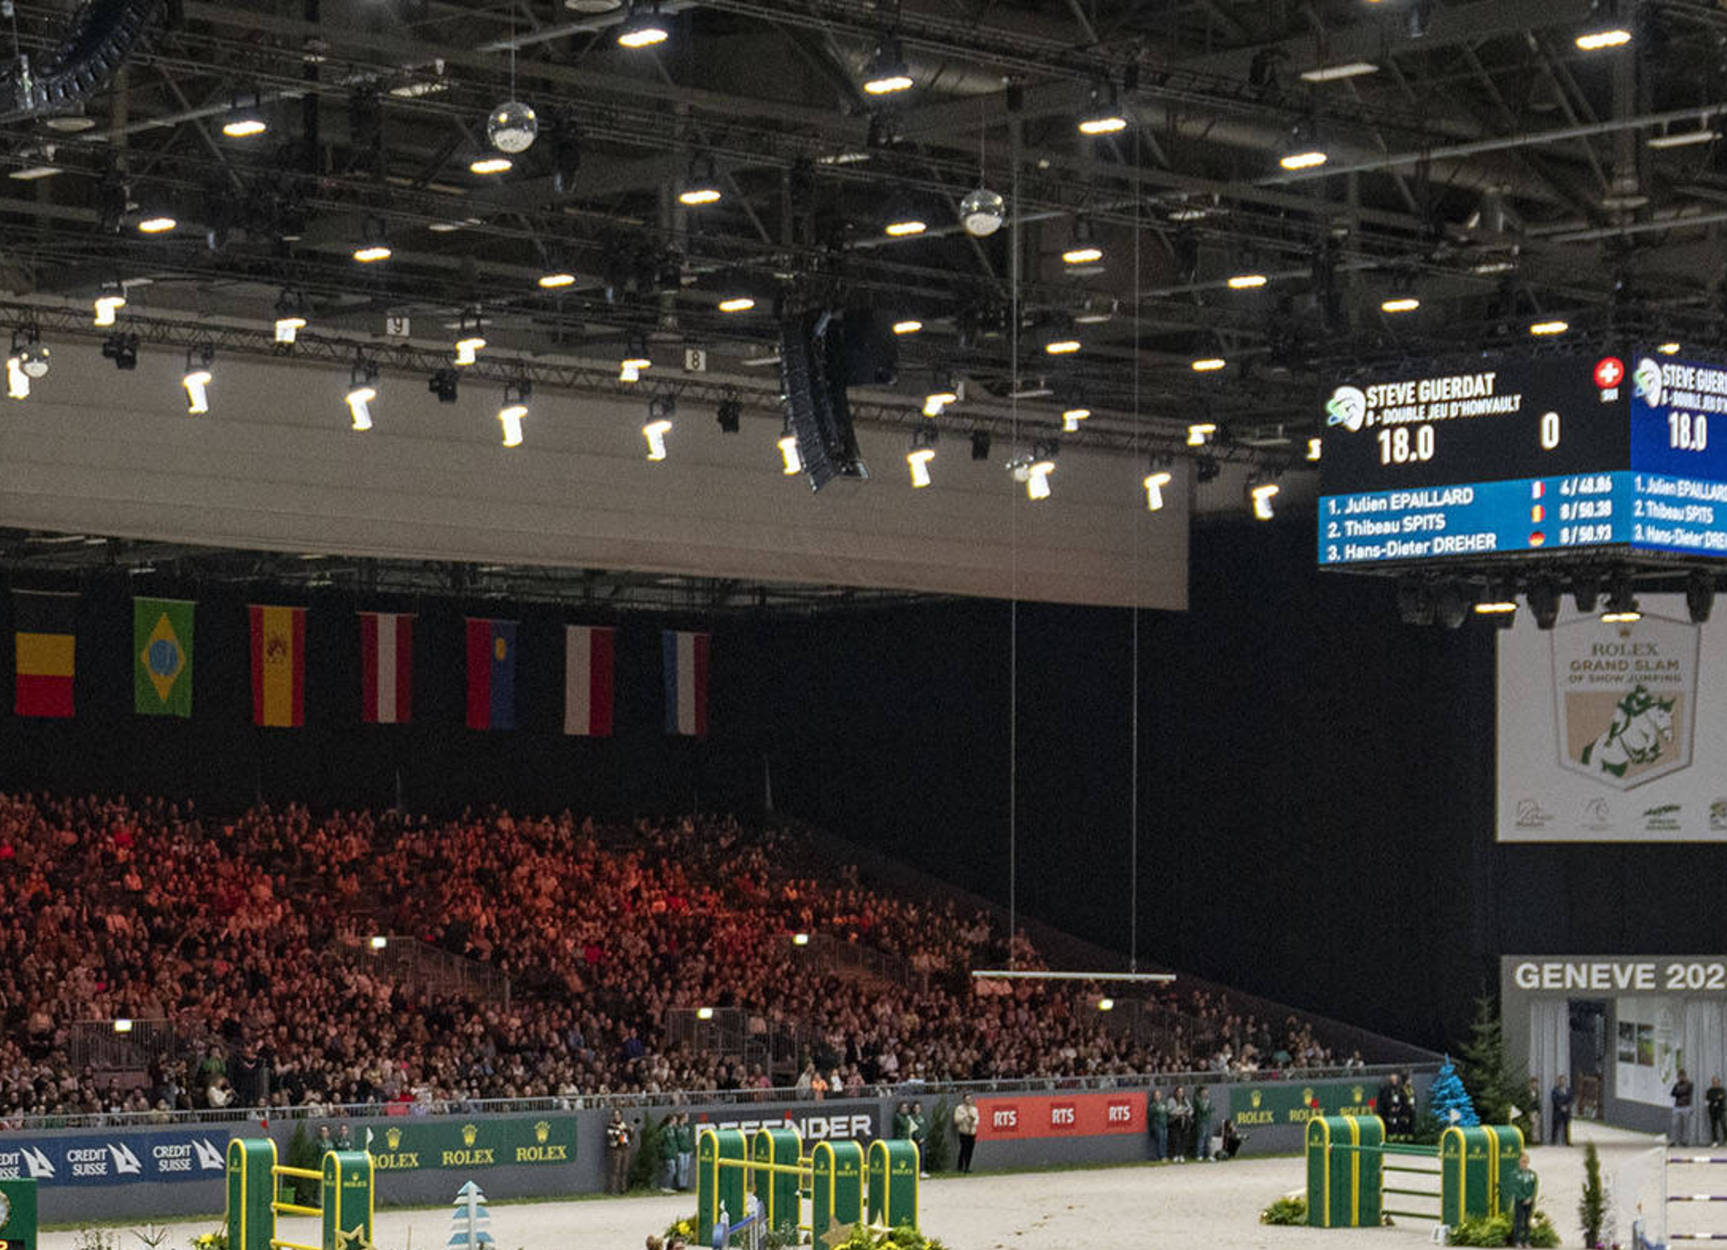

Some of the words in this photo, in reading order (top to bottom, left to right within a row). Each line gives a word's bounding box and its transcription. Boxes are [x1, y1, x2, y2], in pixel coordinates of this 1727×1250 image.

[692, 351, 701, 370] 8
[1662, 363, 1696, 389] STEVE
[1696, 368, 1727, 394] GUER
[1366, 381, 1417, 408] STEVE
[1418, 372, 1497, 402] GUERDAT
[1382, 404, 1427, 425] DOUBLE
[1427, 401, 1449, 420] JEU
[1541, 411, 1560, 450] 0
[1668, 410, 1708, 452] 18.0
[1378, 424, 1435, 465] 18.0
[1328, 499, 1341, 515] 1.
[1344, 494, 1388, 515] Julien
[1389, 487, 1474, 510] EPAILLARD
[1685, 505, 1714, 525] SPITS
[1328, 522, 1341, 539] 2.
[1344, 517, 1400, 537] Thibeau
[1402, 513, 1446, 533] SPITS
[1328, 544, 1341, 561] 3.
[1345, 540, 1431, 560] Hans-Dieter
[1432, 532, 1498, 553] DREHER
[1592, 642, 1660, 657] ROLEX
[1570, 659, 1630, 672] GRAND
[1634, 659, 1680, 671] SLAM
[1589, 673, 1625, 683] SHOW
[1627, 673, 1683, 683] JUMPING
[1515, 962, 1656, 990] GENEVE
[993, 1110, 1017, 1127] RTS
[1051, 1108, 1075, 1124] RTS
[1108, 1105, 1131, 1121] RTS
[1238, 1110, 1274, 1124] ROLEX
[66, 1148, 108, 1163] CREDIT
[153, 1144, 193, 1159] CREDIT
[441, 1149, 495, 1167] ROLEX
[515, 1145, 568, 1162] ROLEX
[73, 1161, 109, 1177] SUISSE
[158, 1157, 193, 1173] SUISSE
